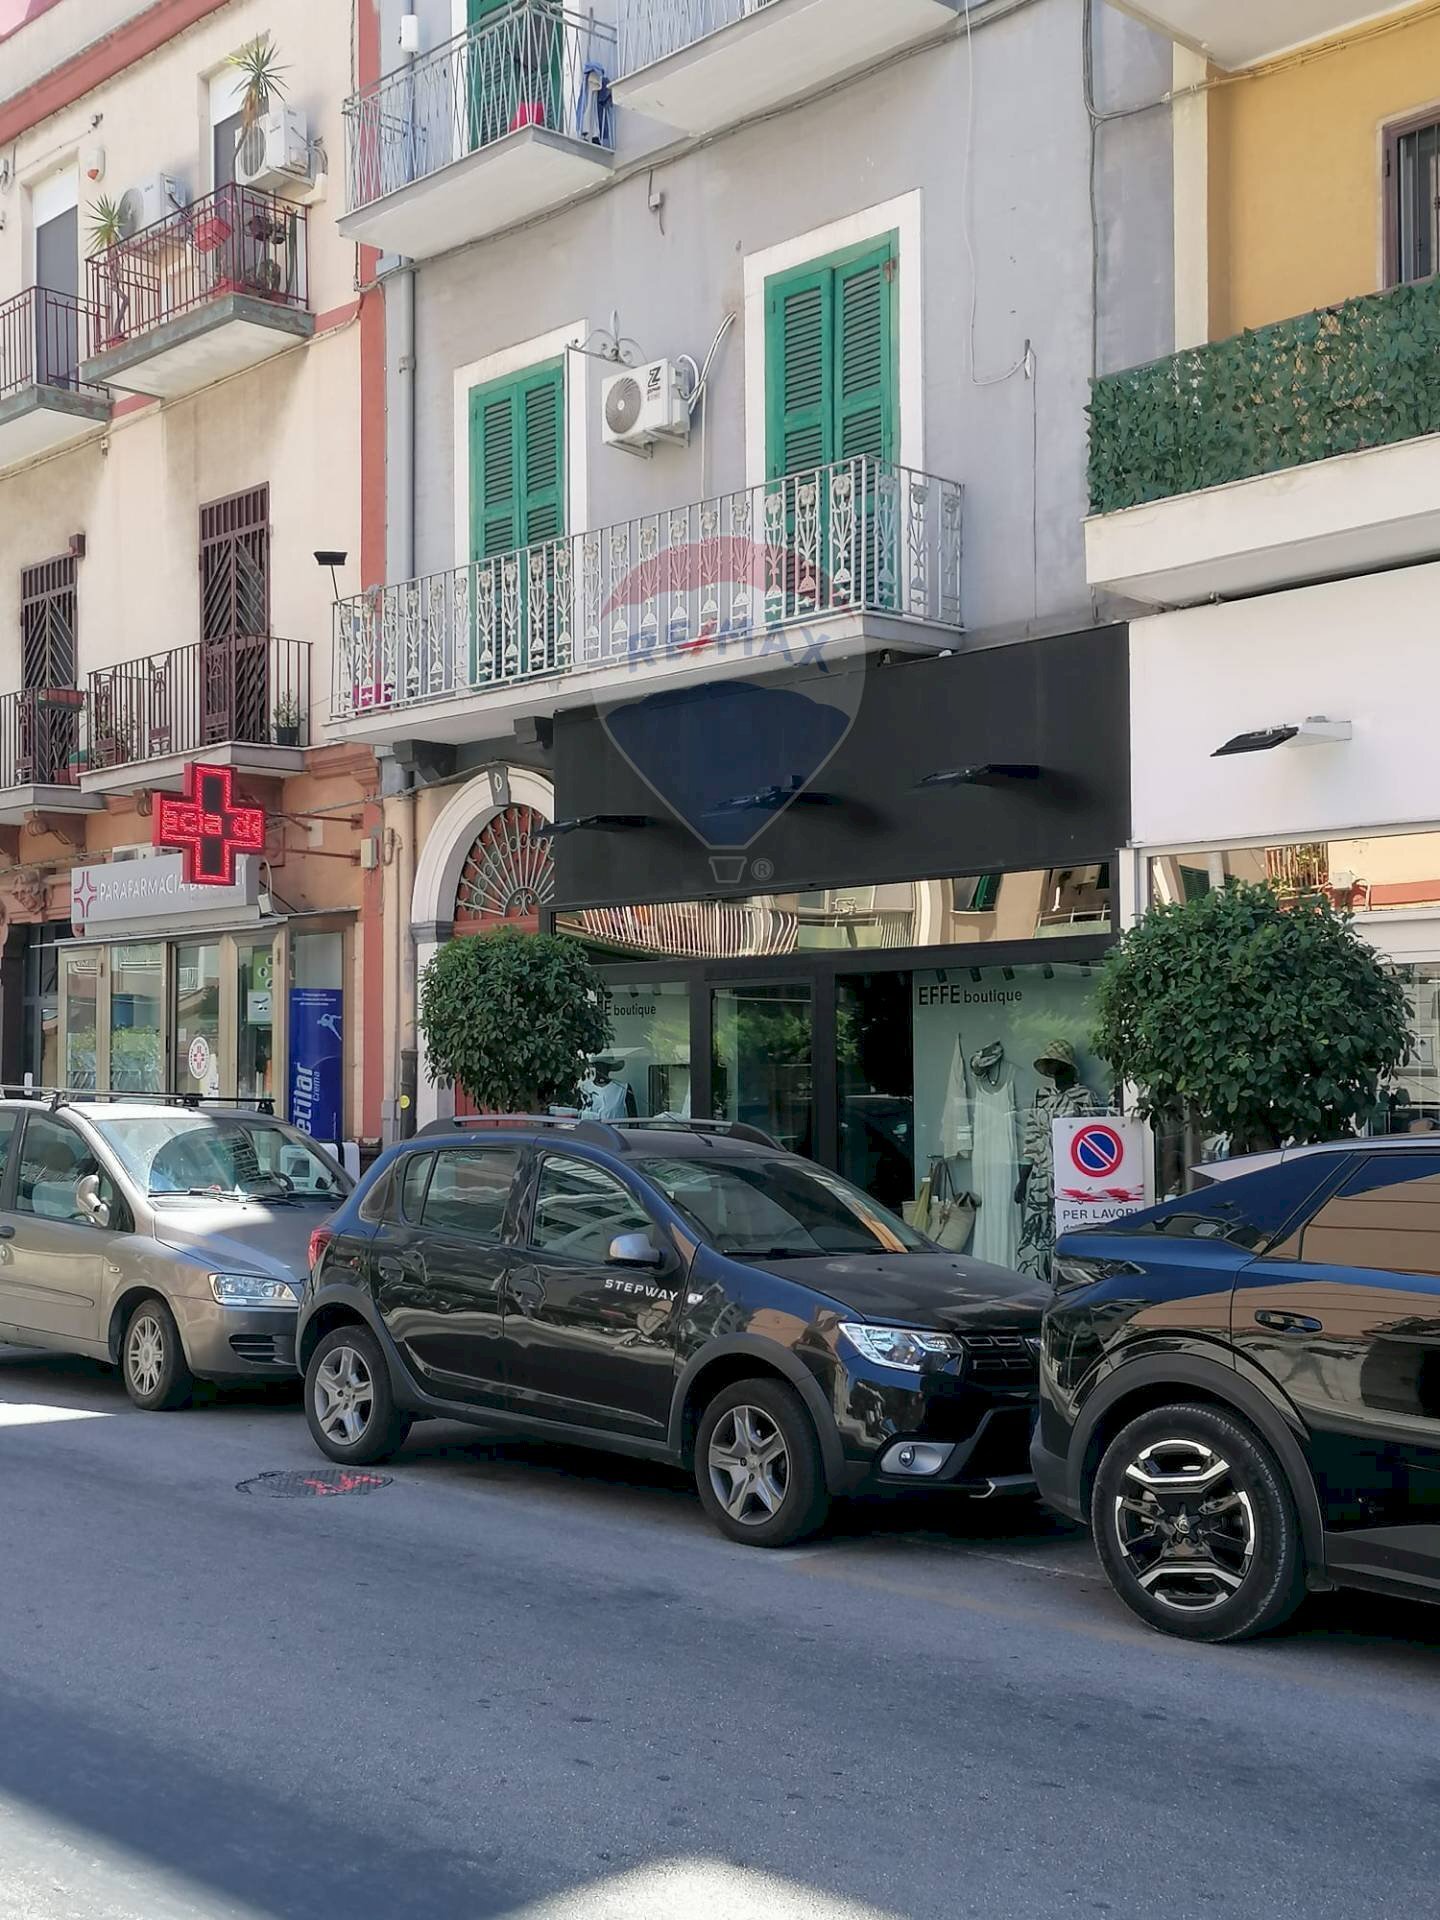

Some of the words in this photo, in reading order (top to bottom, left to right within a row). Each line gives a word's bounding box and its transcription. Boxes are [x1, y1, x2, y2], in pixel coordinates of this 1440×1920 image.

[100, 873, 187, 902] PARAFARMACIA
[918, 984, 961, 1005] EFFE
[963, 989, 1023, 1005] boutique
[613, 1002, 657, 1018] boutique
[312, 1071, 321, 1102] Crema
[294, 1062, 313, 1135] etilar
[1063, 1209, 1088, 1219] PER
[604, 1278, 678, 1301] STEPWAY
